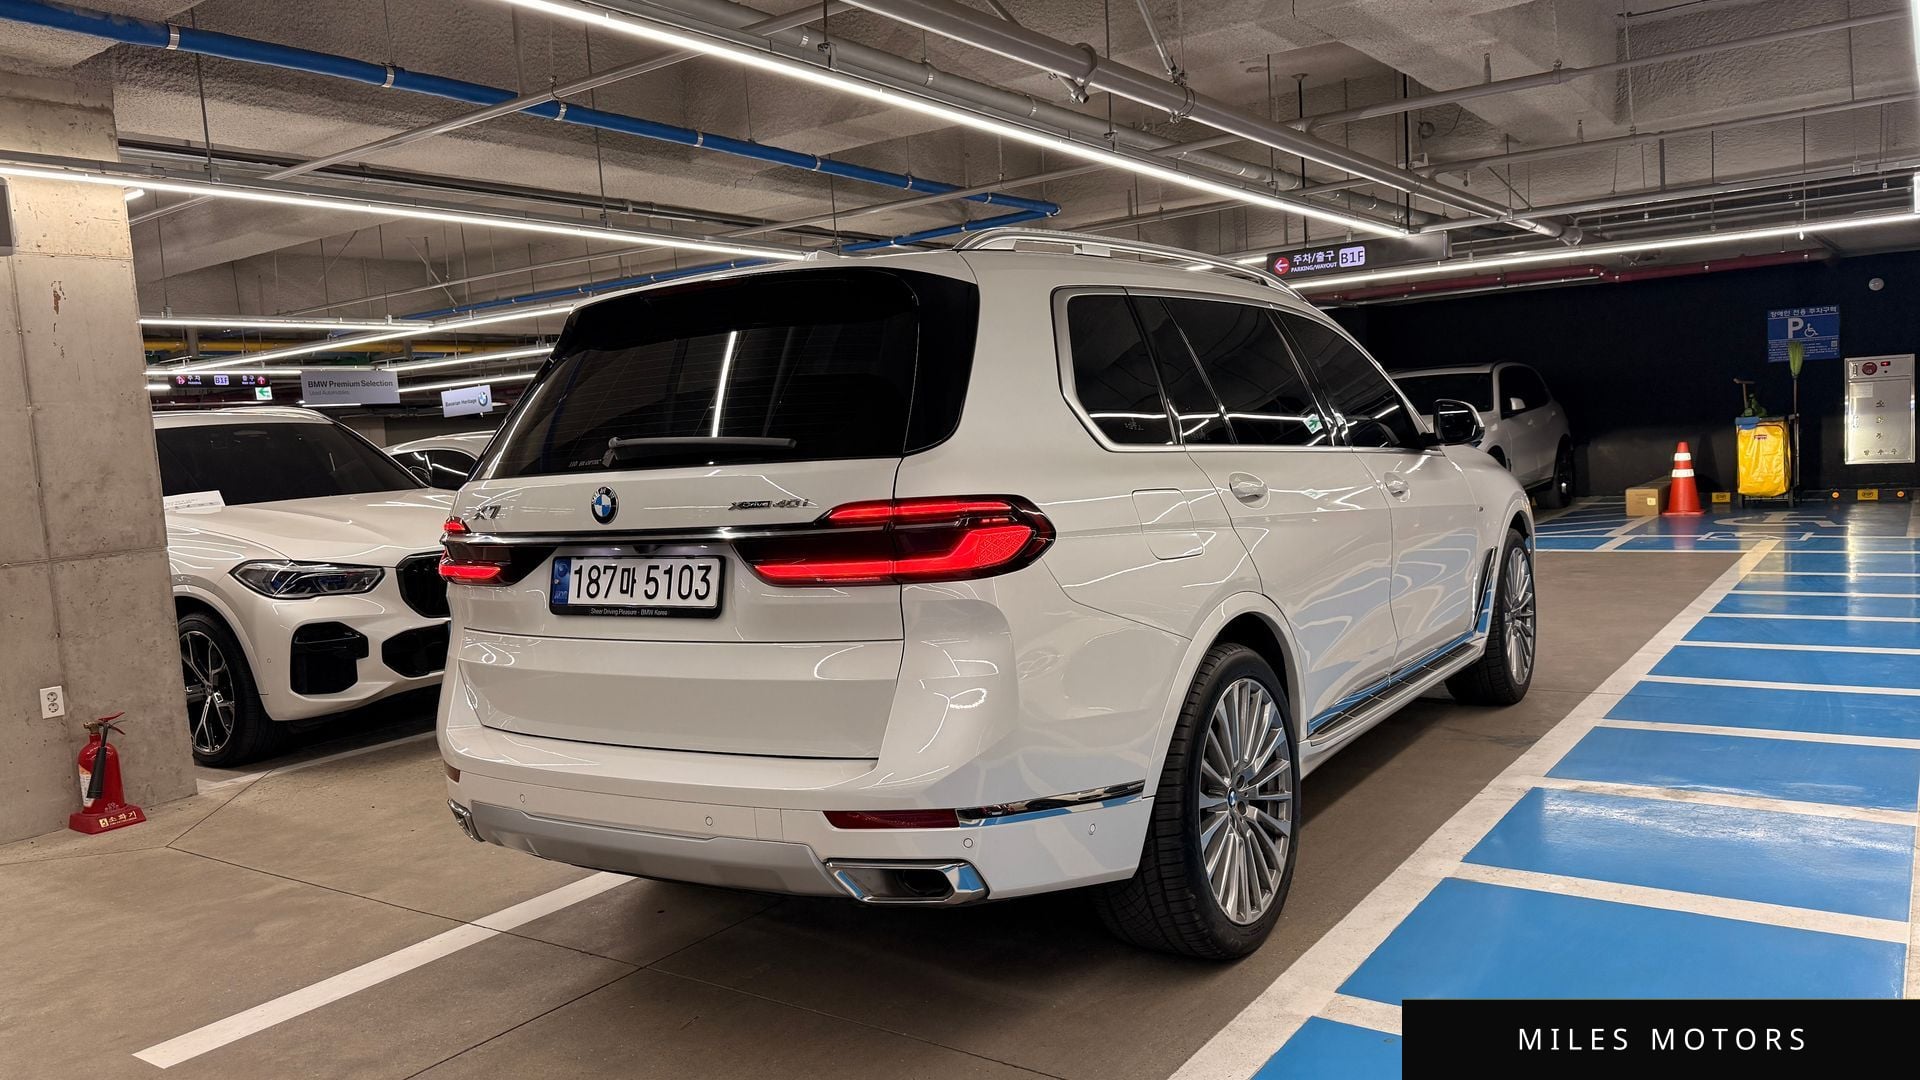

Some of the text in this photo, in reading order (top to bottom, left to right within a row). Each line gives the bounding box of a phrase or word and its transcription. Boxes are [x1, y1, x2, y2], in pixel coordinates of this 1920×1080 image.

[1293, 250, 1335, 266] 주차/출구
[1341, 250, 1364, 264] B1F
[1770, 310, 1791, 318] 장애인
[1787, 317, 1804, 339] P
[307, 379, 394, 388] BMW Premium Selection
[473, 505, 501, 520] X7
[573, 564, 713, 600] 187마 5103
[603, 607, 619, 616] Driving
